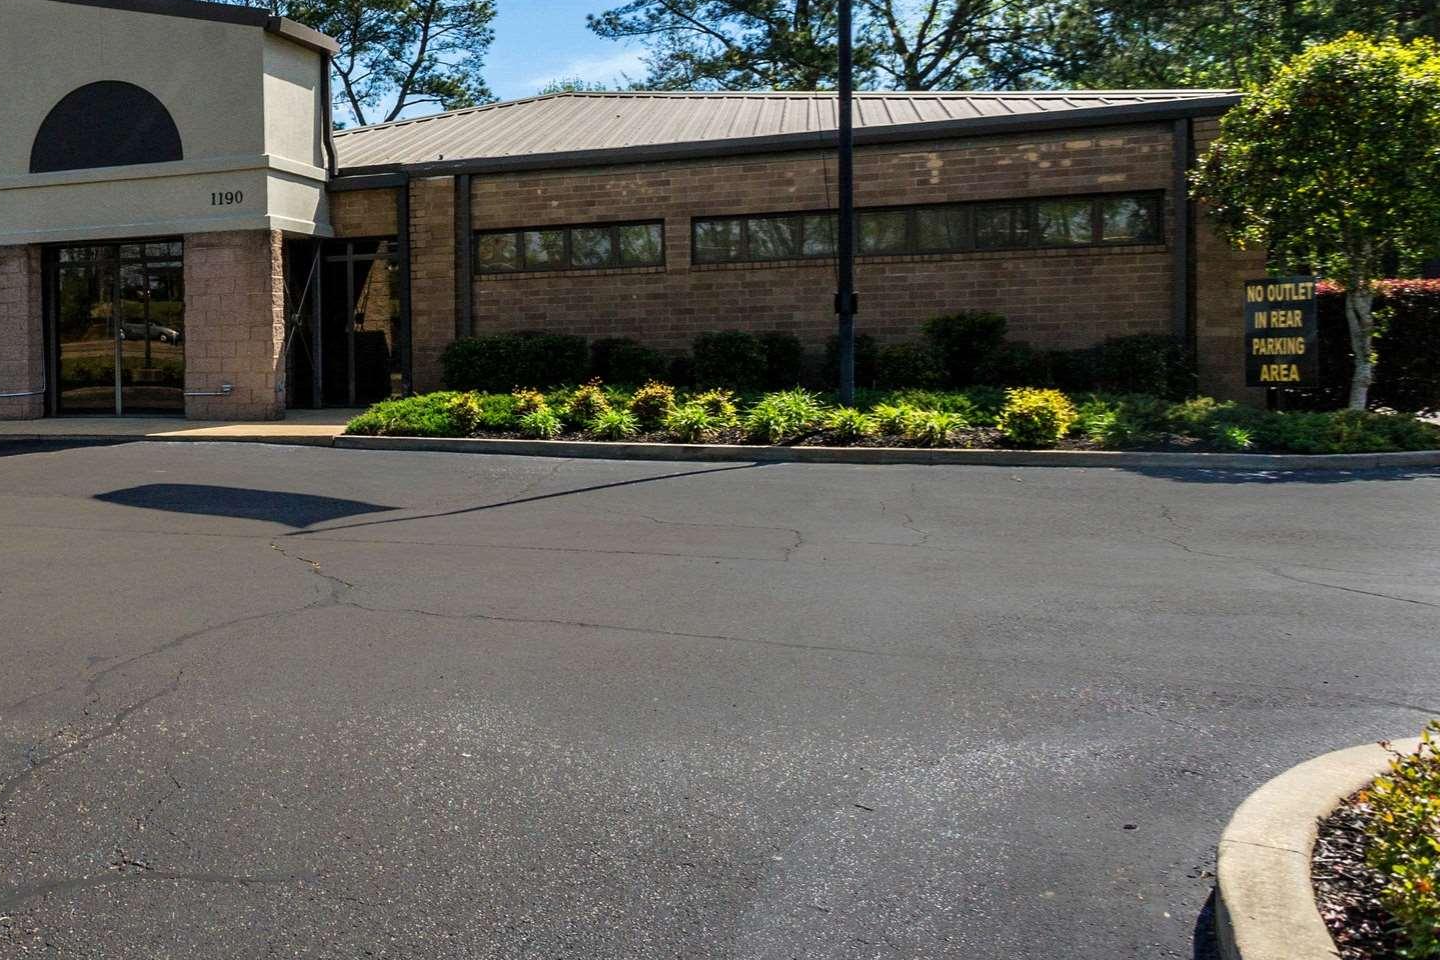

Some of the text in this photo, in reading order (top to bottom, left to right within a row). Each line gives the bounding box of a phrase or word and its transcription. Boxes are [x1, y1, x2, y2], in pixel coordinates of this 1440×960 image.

[211, 190, 243, 205] 1190
[1247, 282, 1313, 302] NO OUTLET
[1254, 310, 1302, 328] IN REAR
[1252, 337, 1305, 355] PARKING
[1260, 364, 1300, 381] AREA
